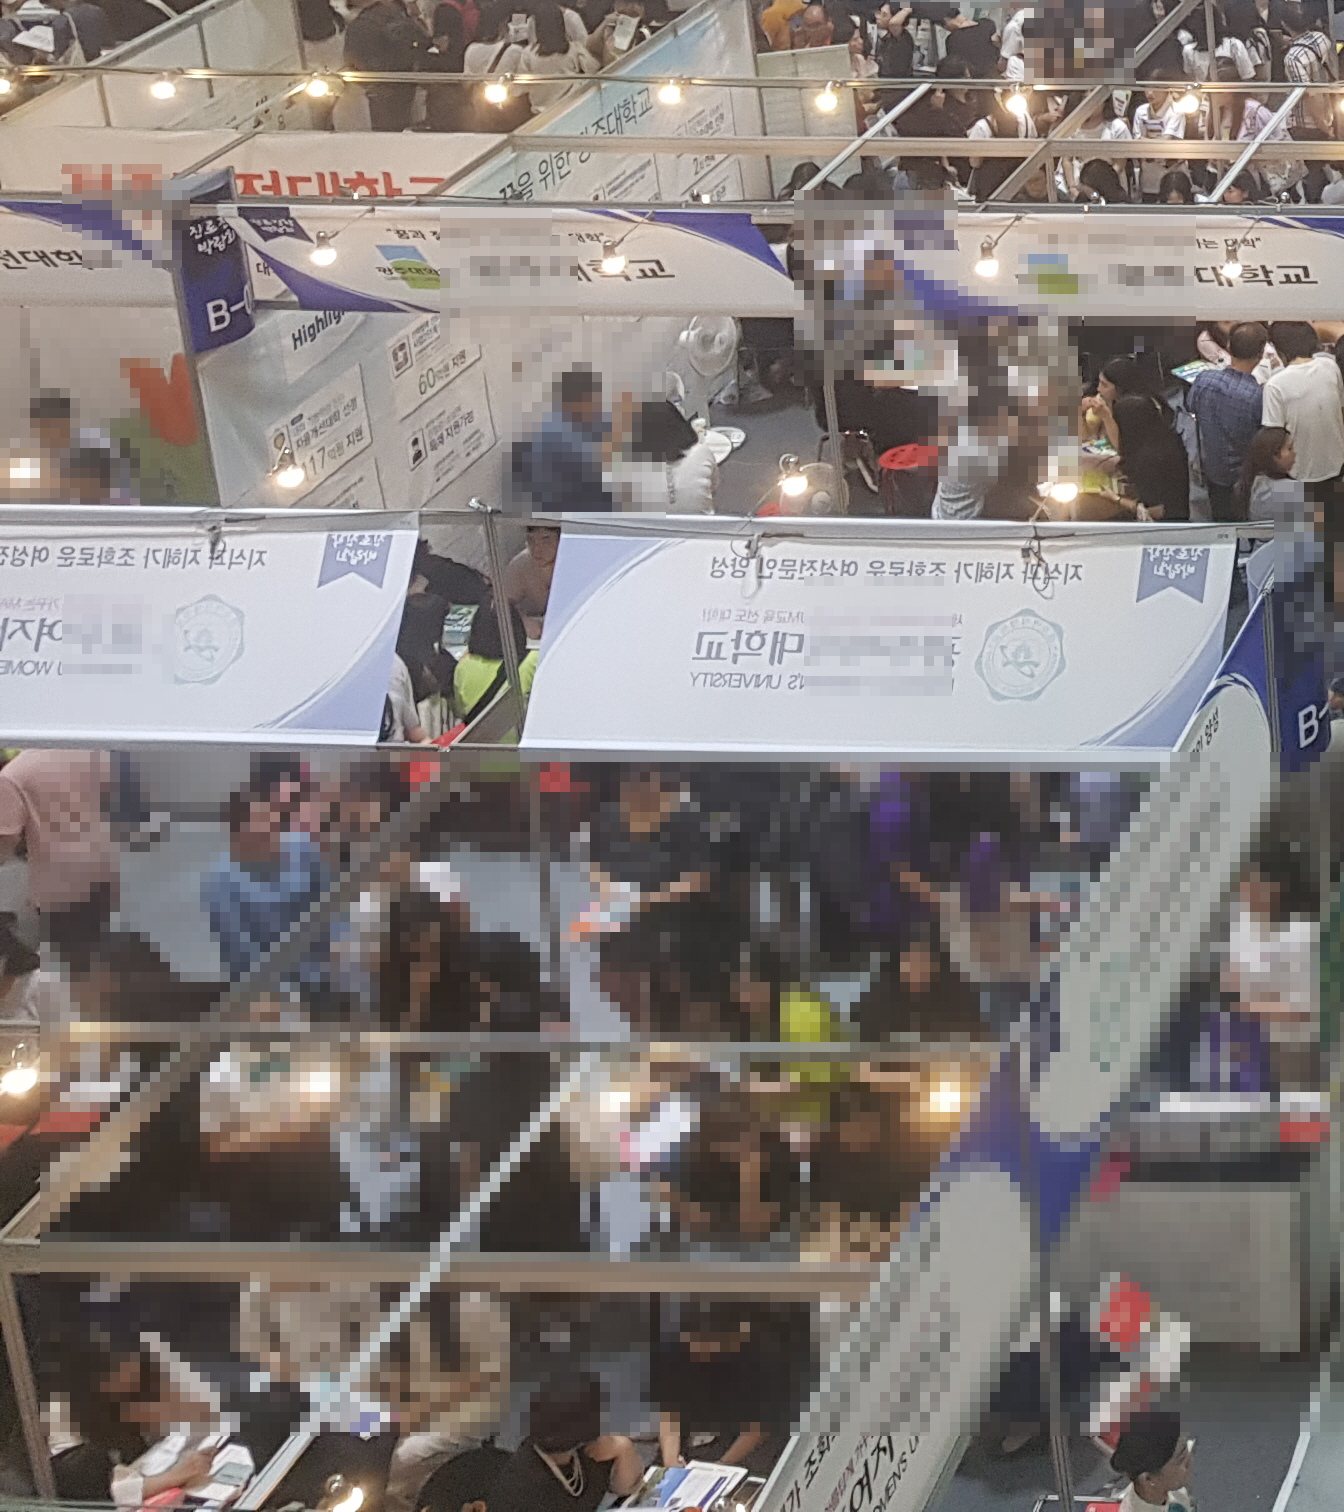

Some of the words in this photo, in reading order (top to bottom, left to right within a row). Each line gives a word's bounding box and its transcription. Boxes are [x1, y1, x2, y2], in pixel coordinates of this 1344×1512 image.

[538, 152, 572, 192] 위한
[345, 424, 365, 448] 지원
[1202, 705, 1221, 747] 양성
